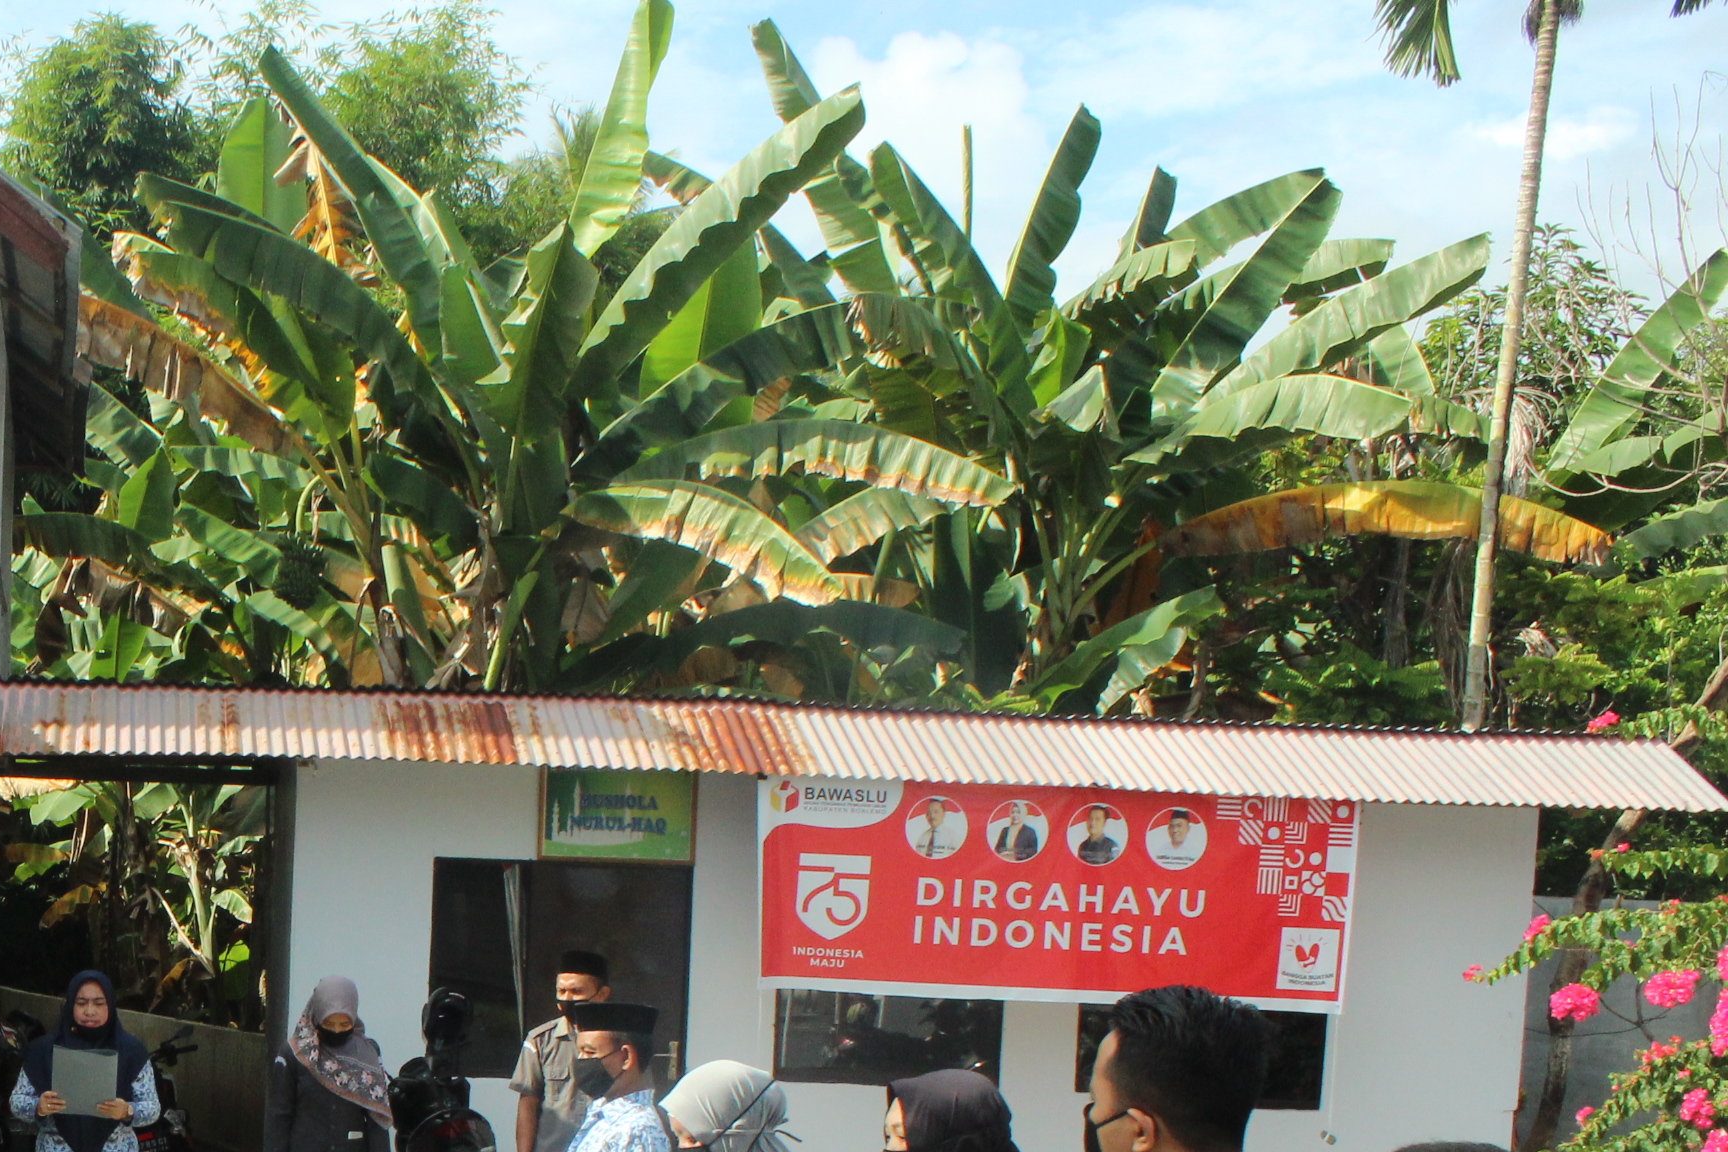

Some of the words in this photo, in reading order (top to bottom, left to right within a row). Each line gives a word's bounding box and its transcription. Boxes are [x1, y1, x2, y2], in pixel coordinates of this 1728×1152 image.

[804, 787, 887, 803] BAWASLU
[916, 877, 1206, 918] DIRGAHAYU
[913, 915, 1188, 956] INDONESIA
[792, 946, 864, 958] INDONESIA
[809, 958, 845, 968] MAJU
